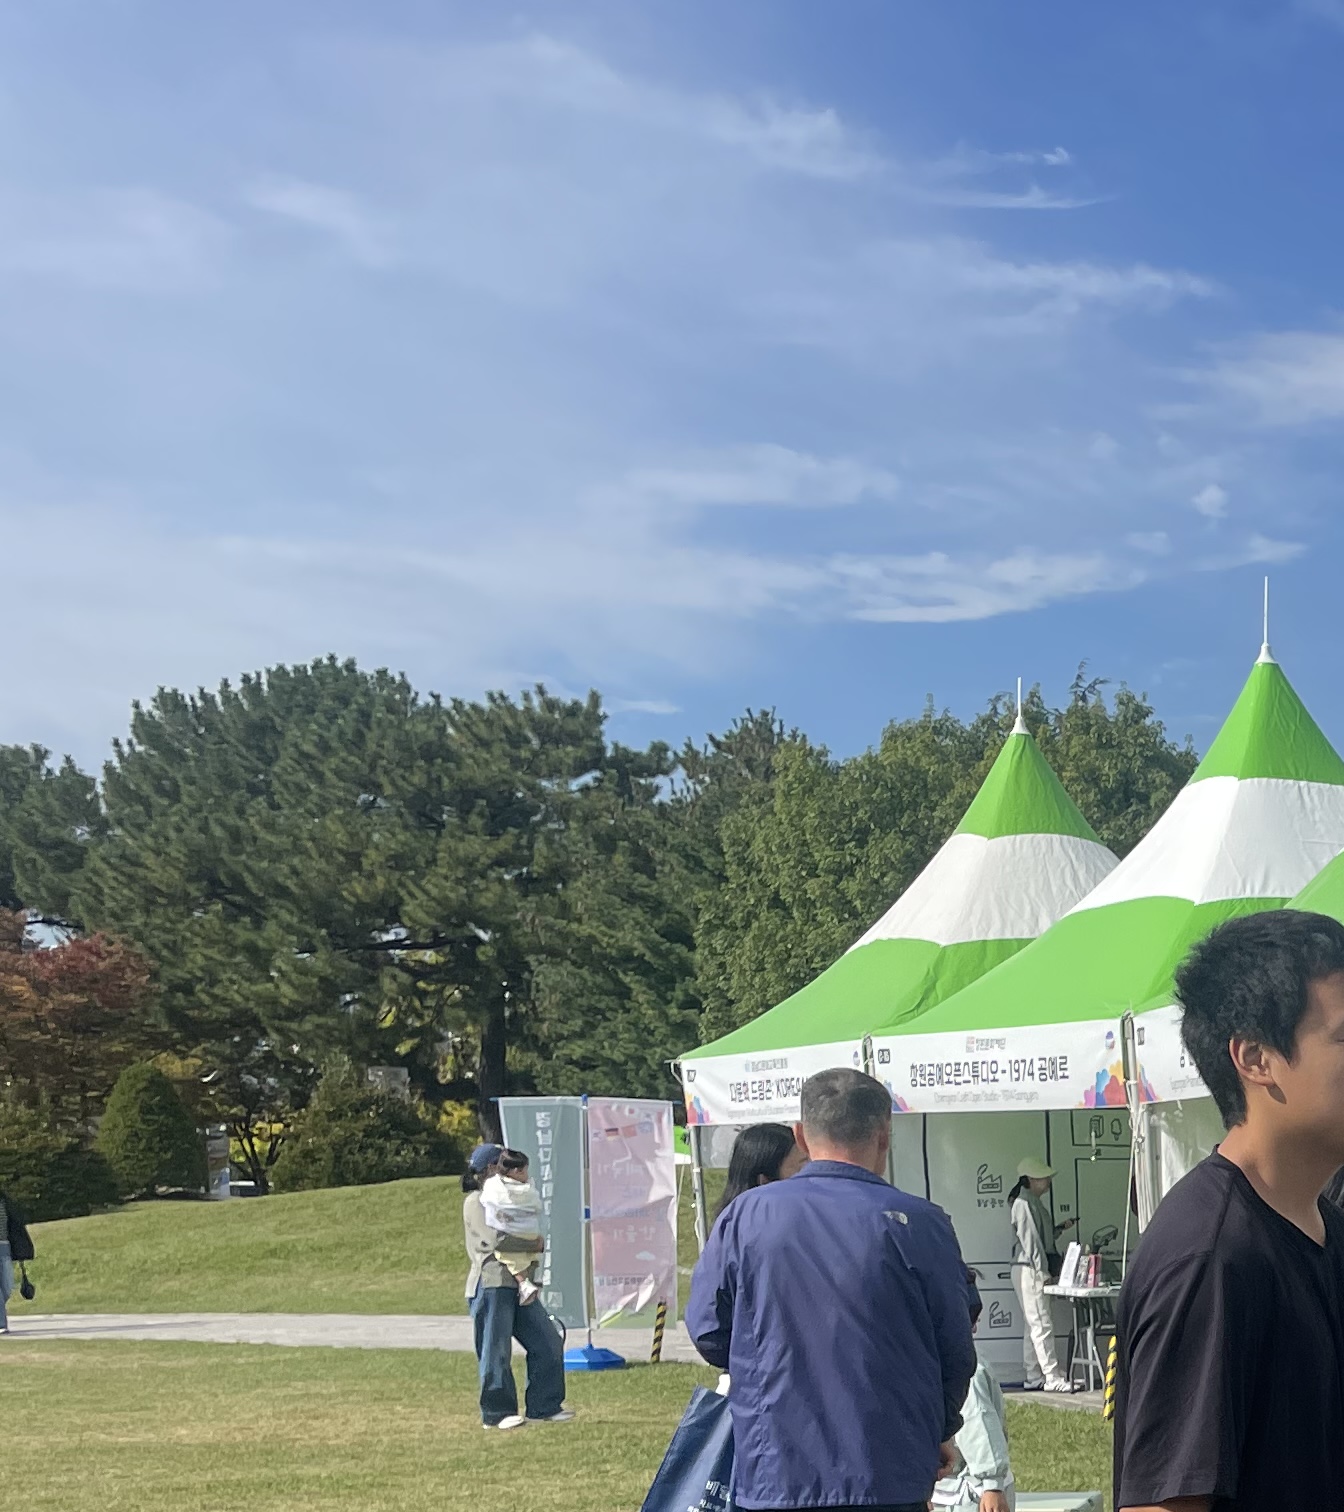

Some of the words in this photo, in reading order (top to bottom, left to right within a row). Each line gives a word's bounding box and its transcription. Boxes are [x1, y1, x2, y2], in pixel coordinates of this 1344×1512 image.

[910, 1059, 999, 1087] 창원공예오픈스튜디오
[1009, 1058, 1035, 1082] 1974
[1038, 1055, 1069, 1083] 공예로
